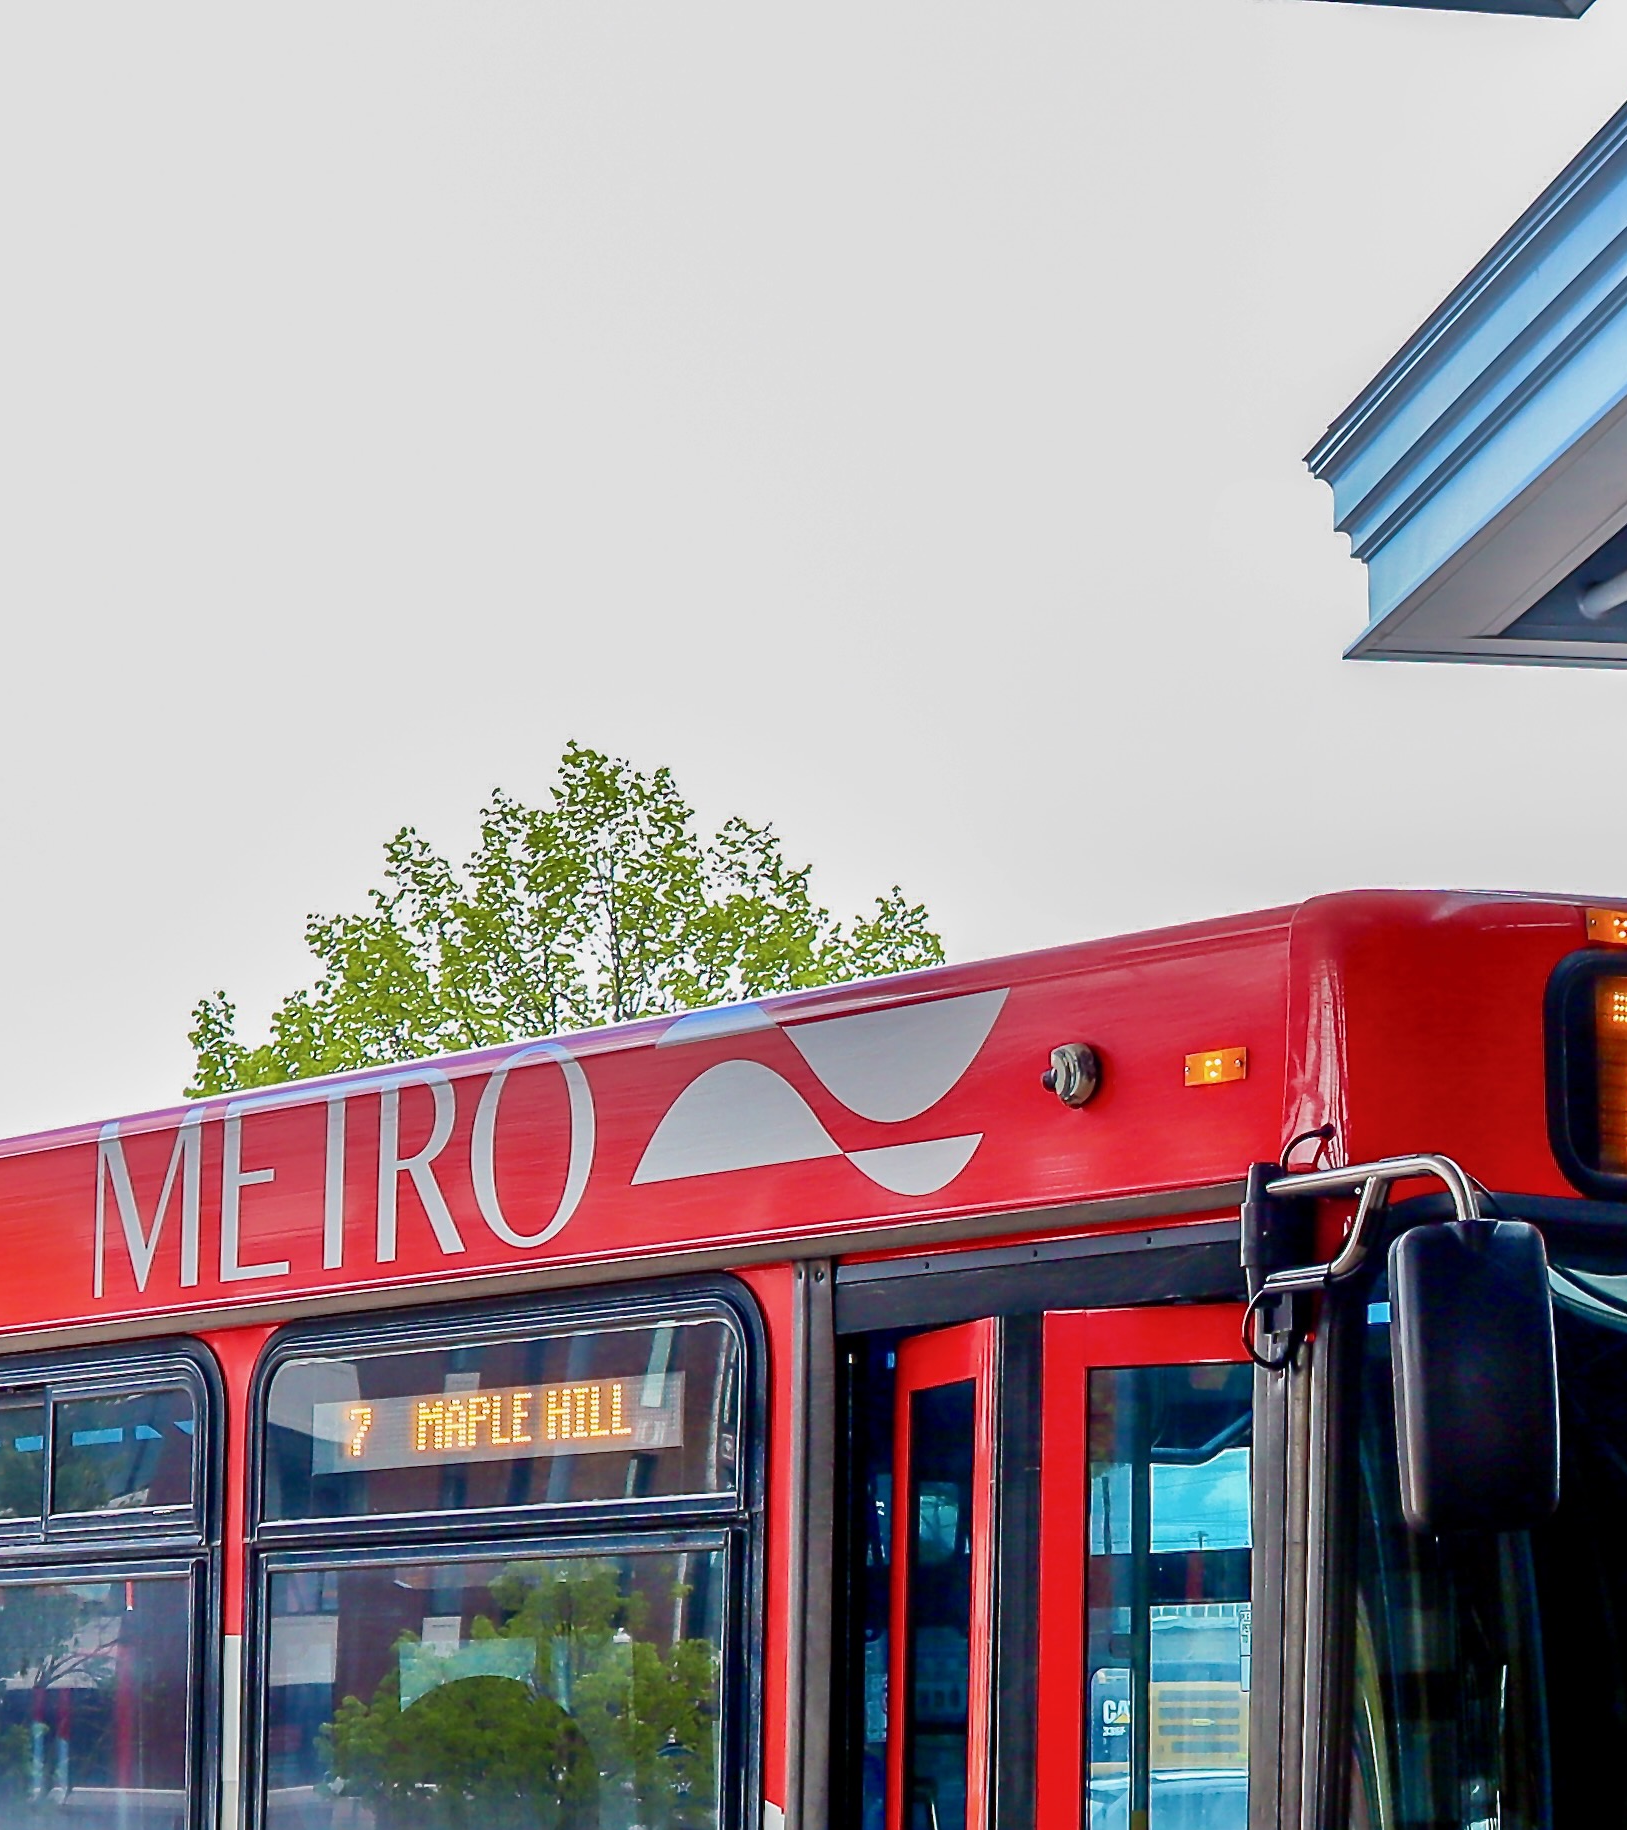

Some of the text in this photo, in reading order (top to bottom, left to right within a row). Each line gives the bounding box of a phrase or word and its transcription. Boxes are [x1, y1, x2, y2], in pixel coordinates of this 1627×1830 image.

[93, 1043, 596, 1299] METRO
[348, 1383, 633, 1458] 7 MAPLE HILL
[1102, 1699, 1131, 1724] CA
